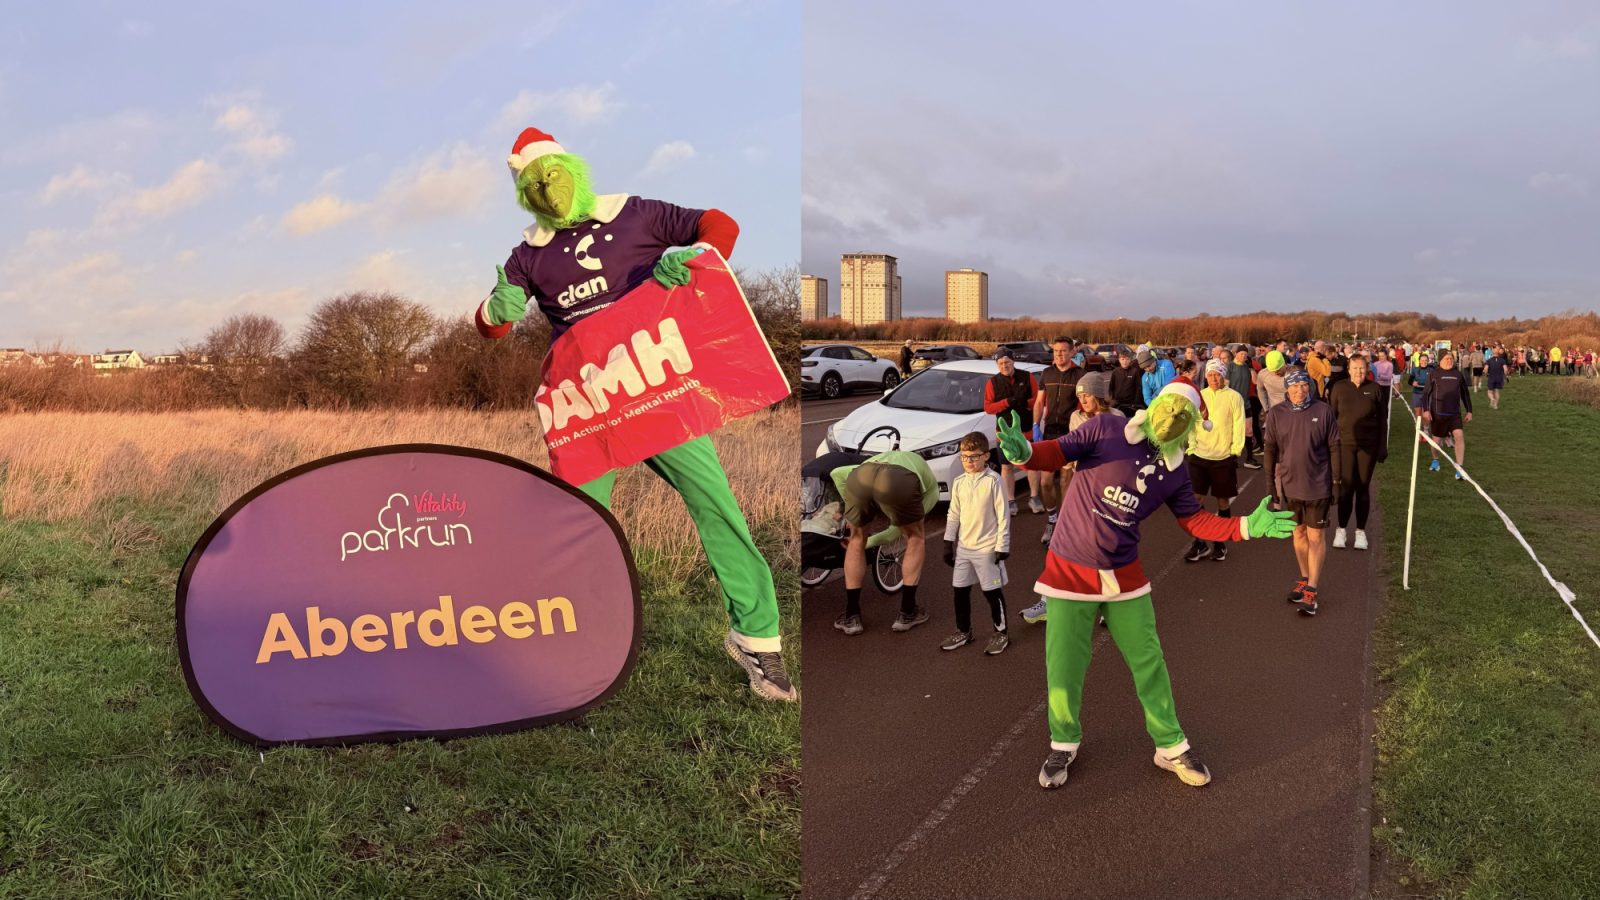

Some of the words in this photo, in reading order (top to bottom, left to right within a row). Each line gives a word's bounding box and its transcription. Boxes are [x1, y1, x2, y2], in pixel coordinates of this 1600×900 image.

[557, 276, 608, 308] clan
[573, 421, 606, 440] Action
[608, 417, 623, 428] for
[624, 396, 663, 420] Mental
[664, 378, 701, 400] Health
[413, 489, 467, 518] Vitality
[1103, 486, 1139, 509] clan
[341, 493, 472, 561] parkrun
[255, 594, 579, 664] Aberdeen
